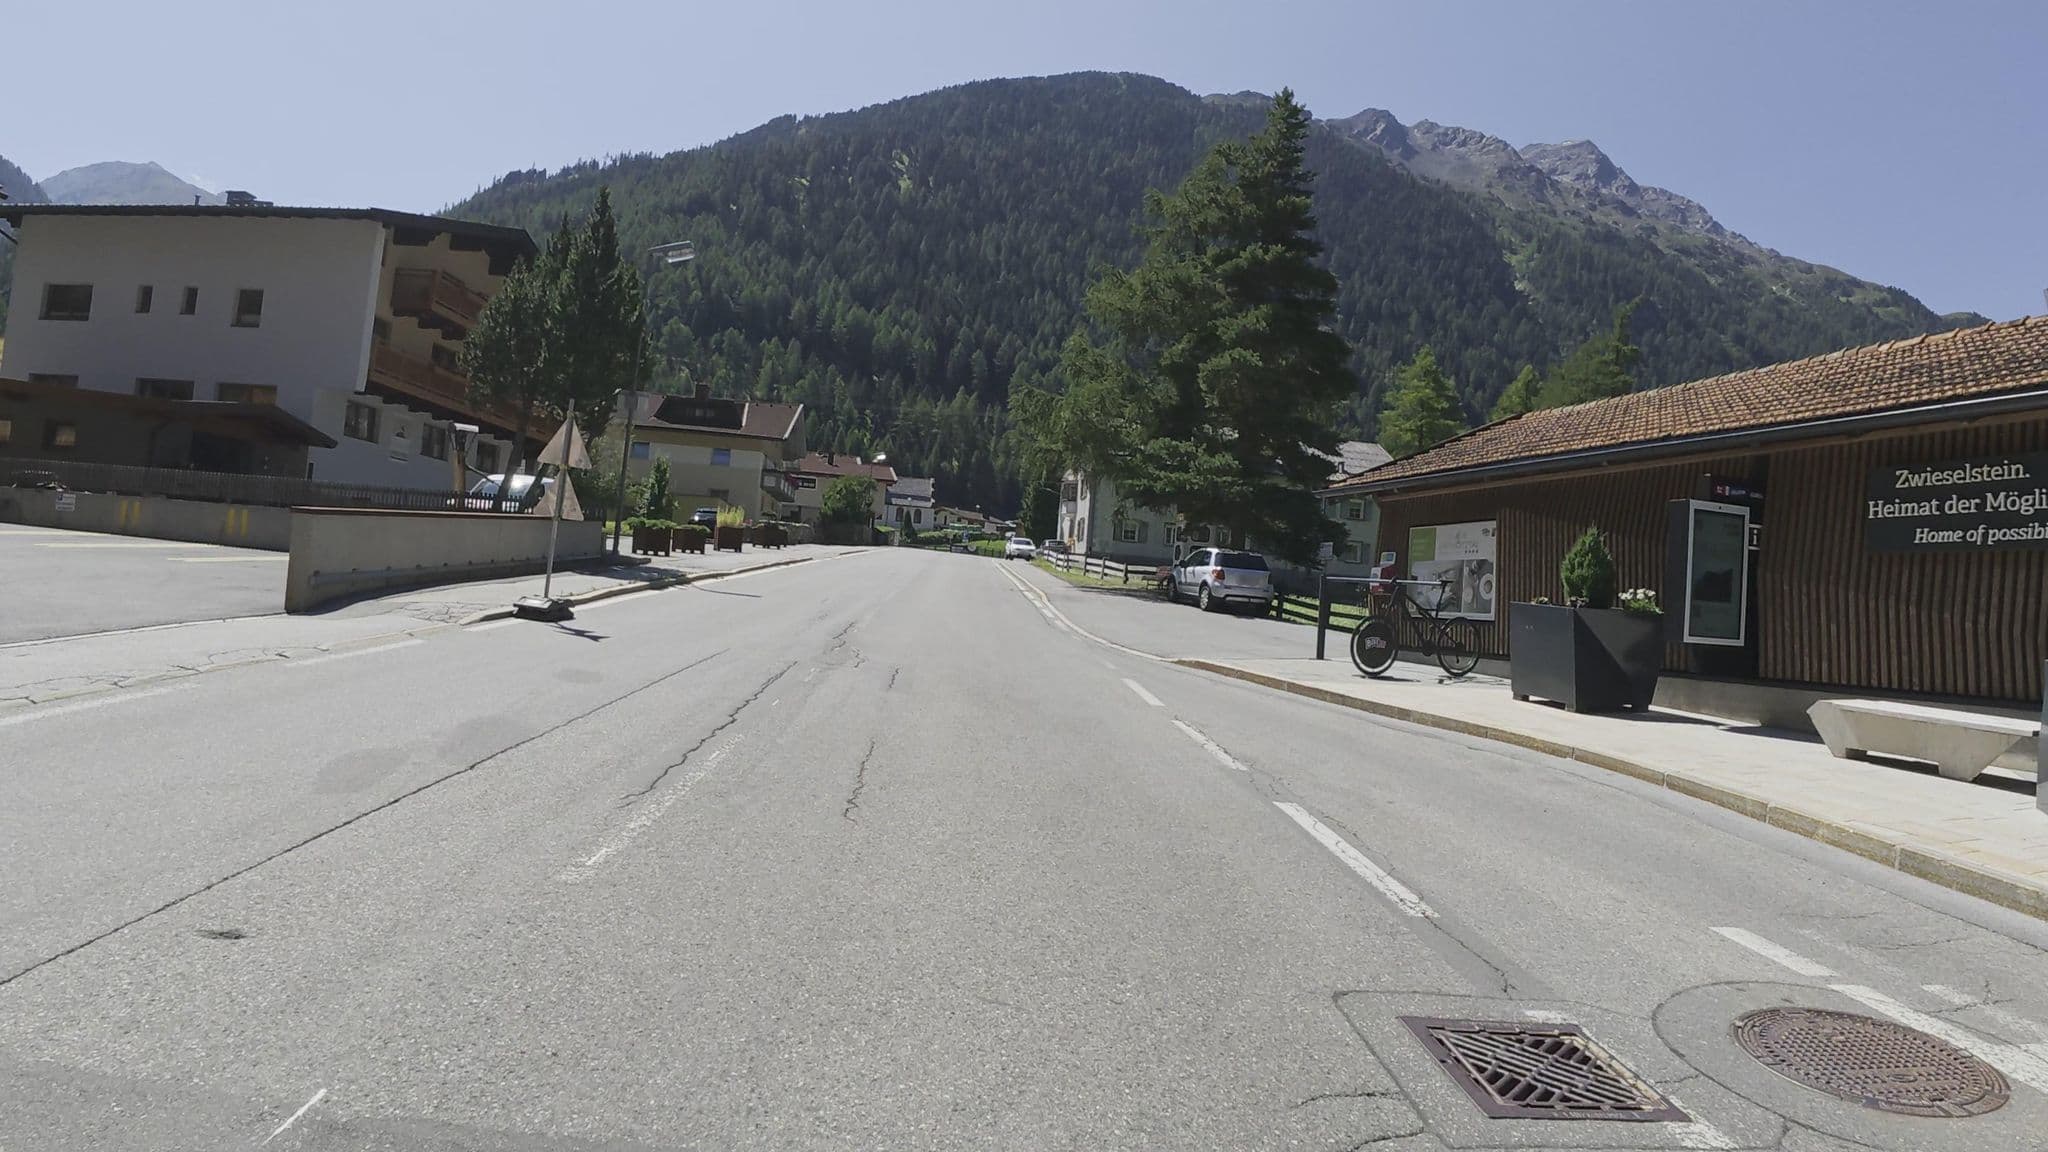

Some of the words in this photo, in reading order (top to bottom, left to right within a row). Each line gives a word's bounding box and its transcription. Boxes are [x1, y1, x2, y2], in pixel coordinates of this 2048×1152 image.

[1895, 460, 2031, 488] Zwieselstein.
[1868, 498, 1940, 519] Heimat
[1944, 494, 1981, 514] der
[1914, 527, 1965, 544] Home
[1966, 524, 1988, 545] of
